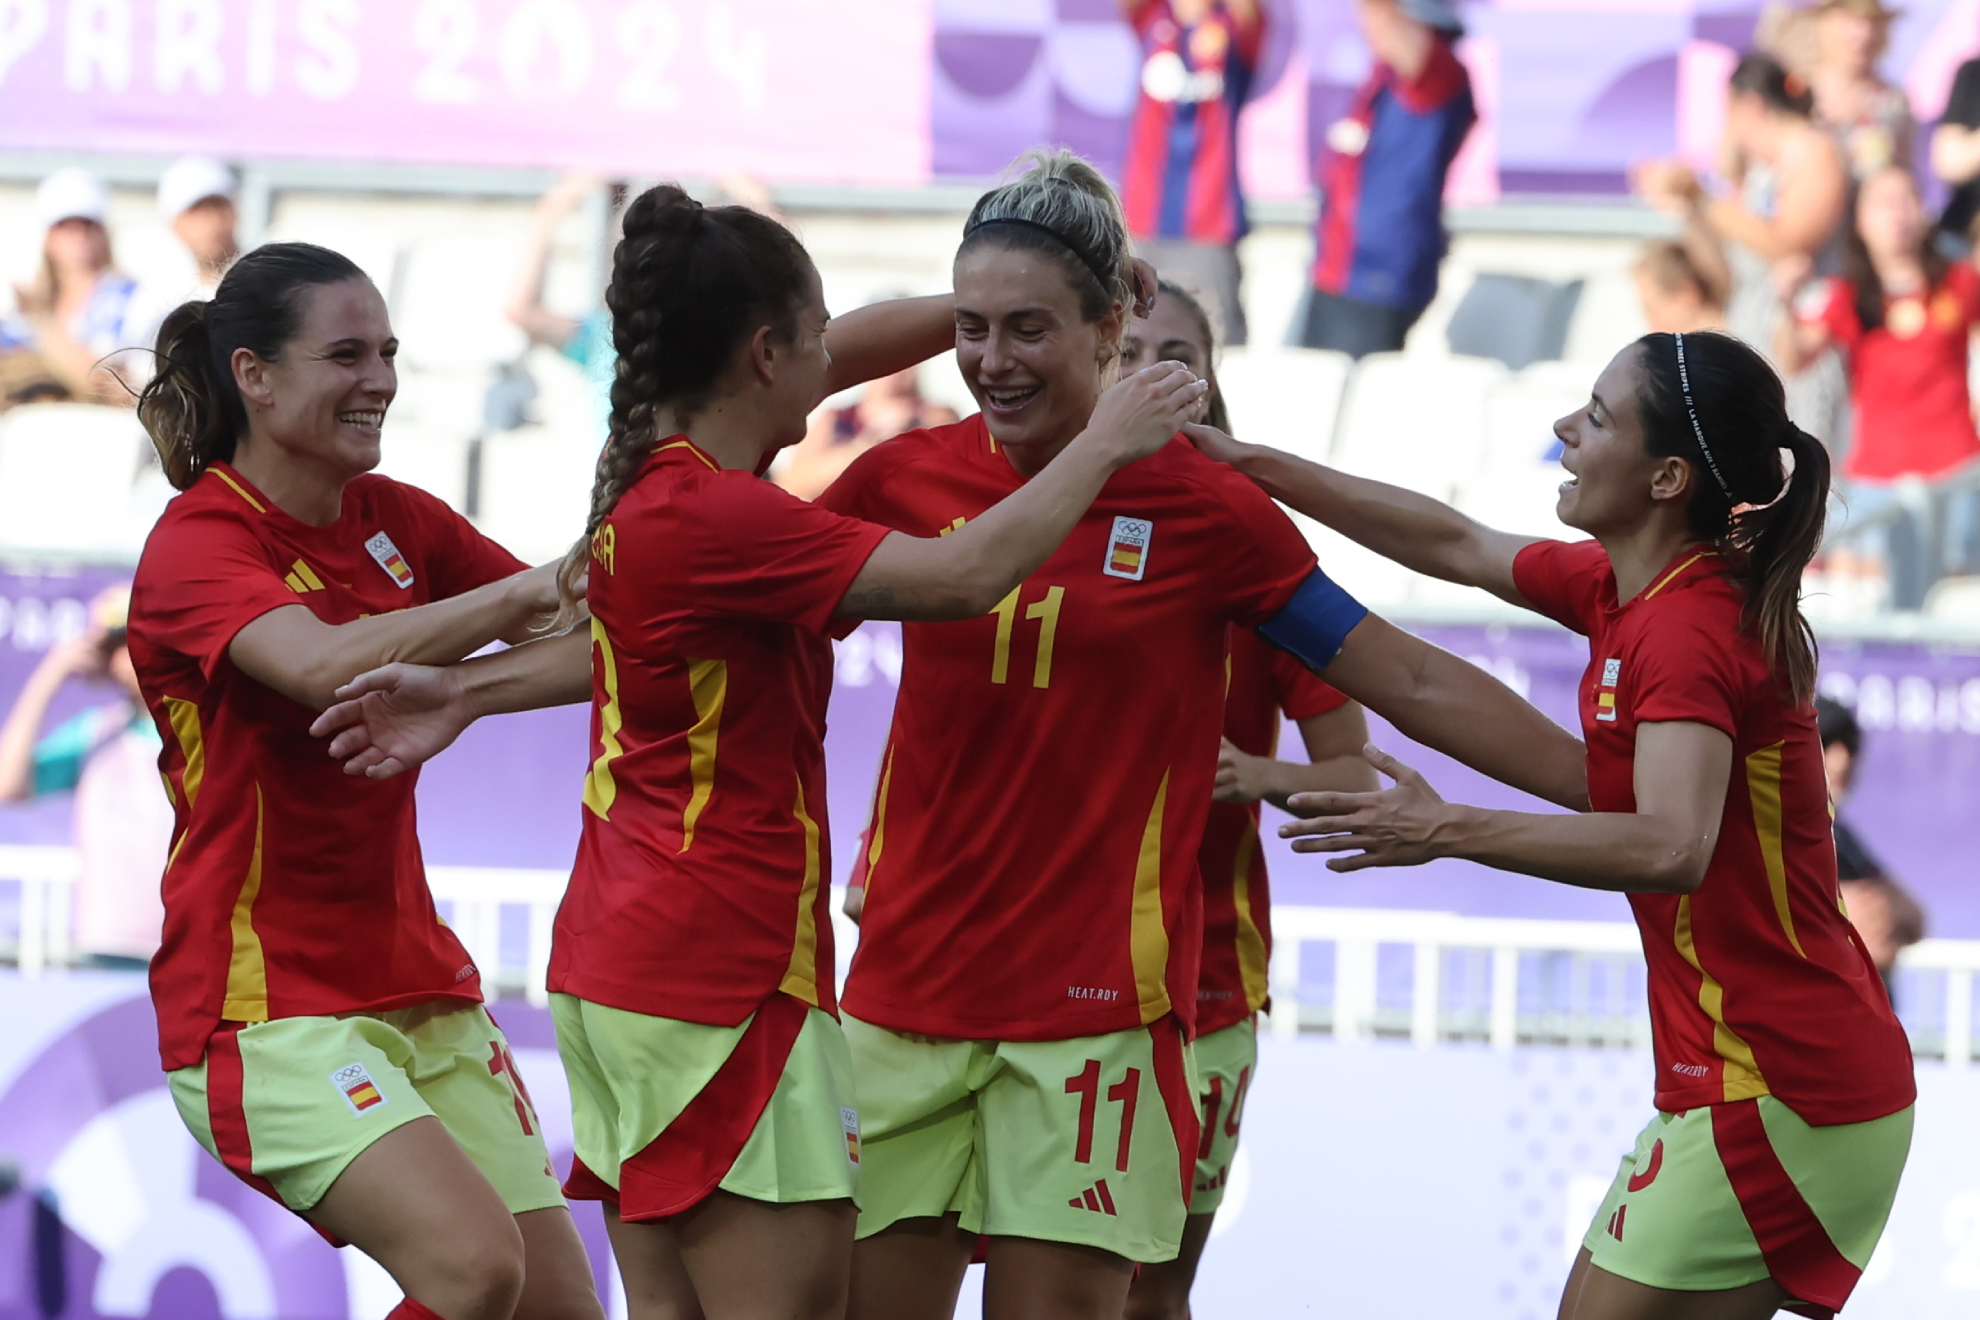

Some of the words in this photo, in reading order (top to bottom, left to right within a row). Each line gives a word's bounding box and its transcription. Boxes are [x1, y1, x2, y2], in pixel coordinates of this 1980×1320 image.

[0, 0, 362, 102] PARIS
[412, 0, 769, 114] 2024
[1679, 364, 1690, 392] STRIPES
[1688, 408, 1697, 420] LA
[1692, 419, 1708, 450] MARQUE
[988, 584, 1065, 689] 11
[1067, 985, 1119, 1001] HEAT.RDY
[1065, 1058, 1141, 1172] 11
